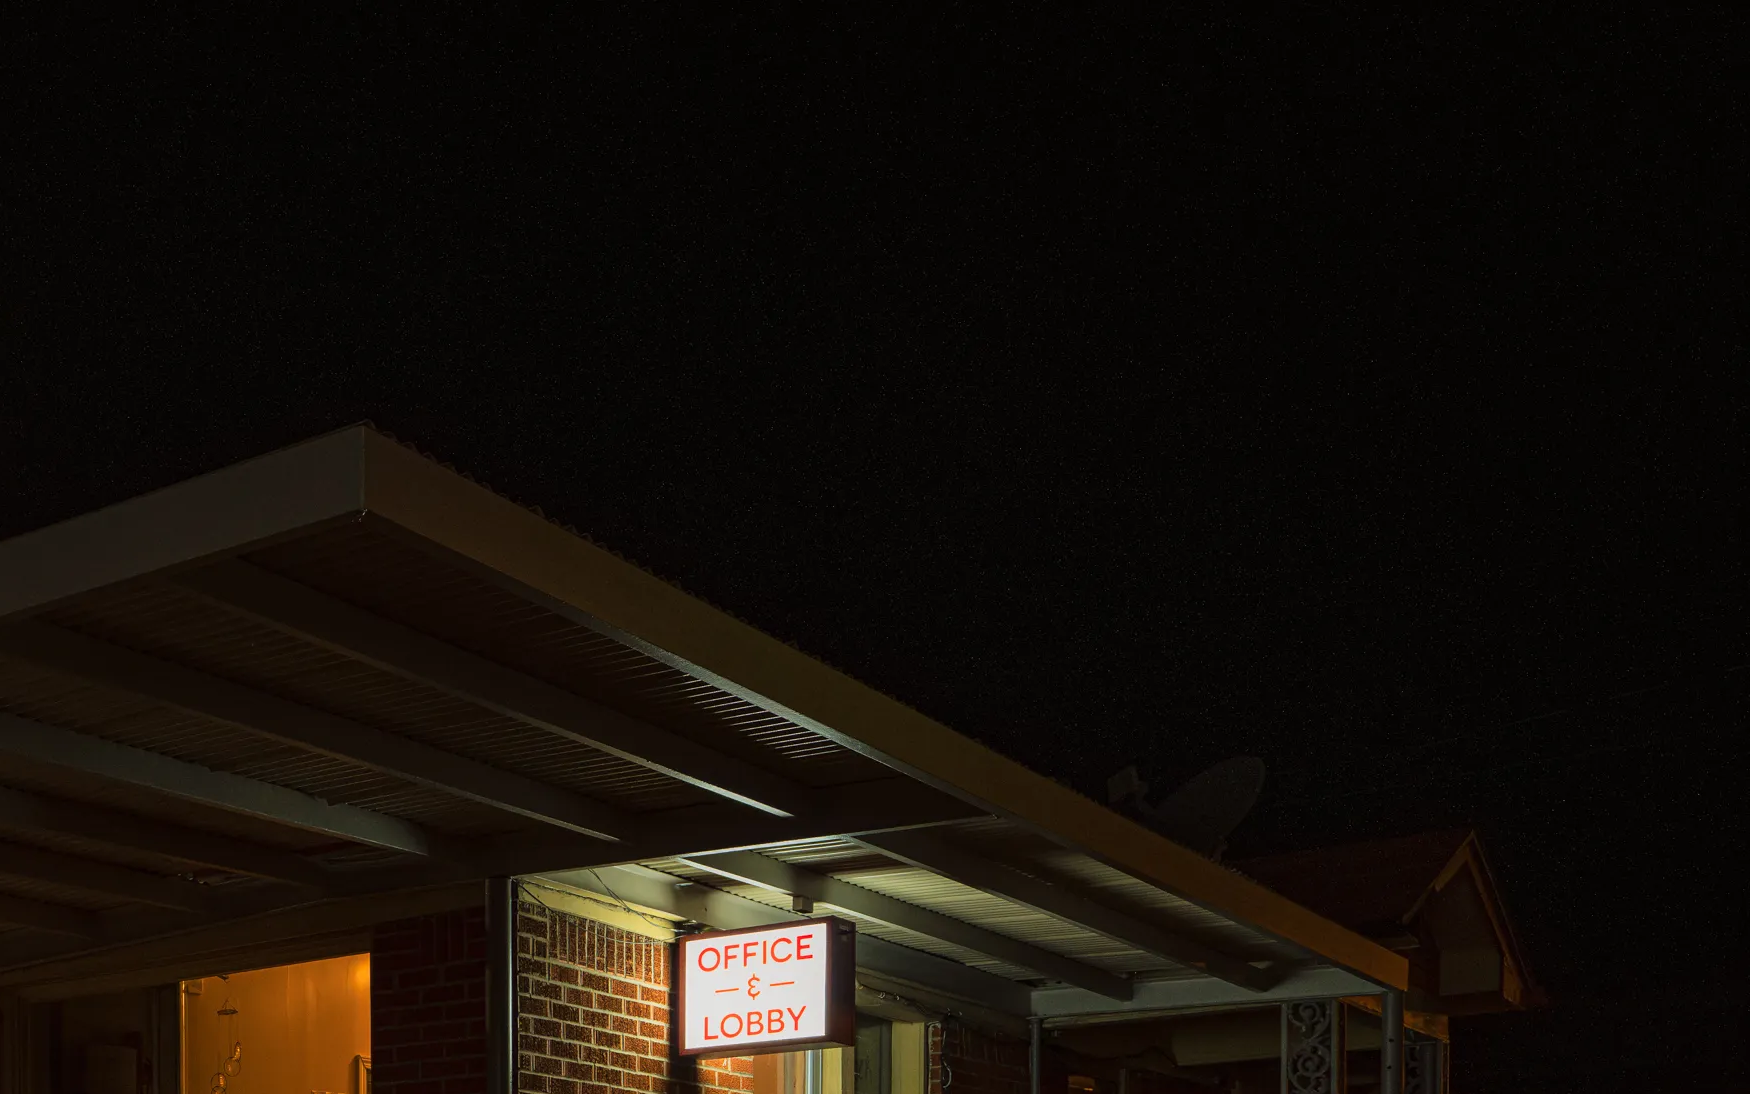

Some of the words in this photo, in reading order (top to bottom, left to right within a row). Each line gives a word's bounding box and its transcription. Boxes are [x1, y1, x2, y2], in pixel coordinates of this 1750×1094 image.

[697, 933, 814, 973] OFFICE
[747, 973, 761, 1001] &
[703, 1005, 807, 1041] LOBBY
